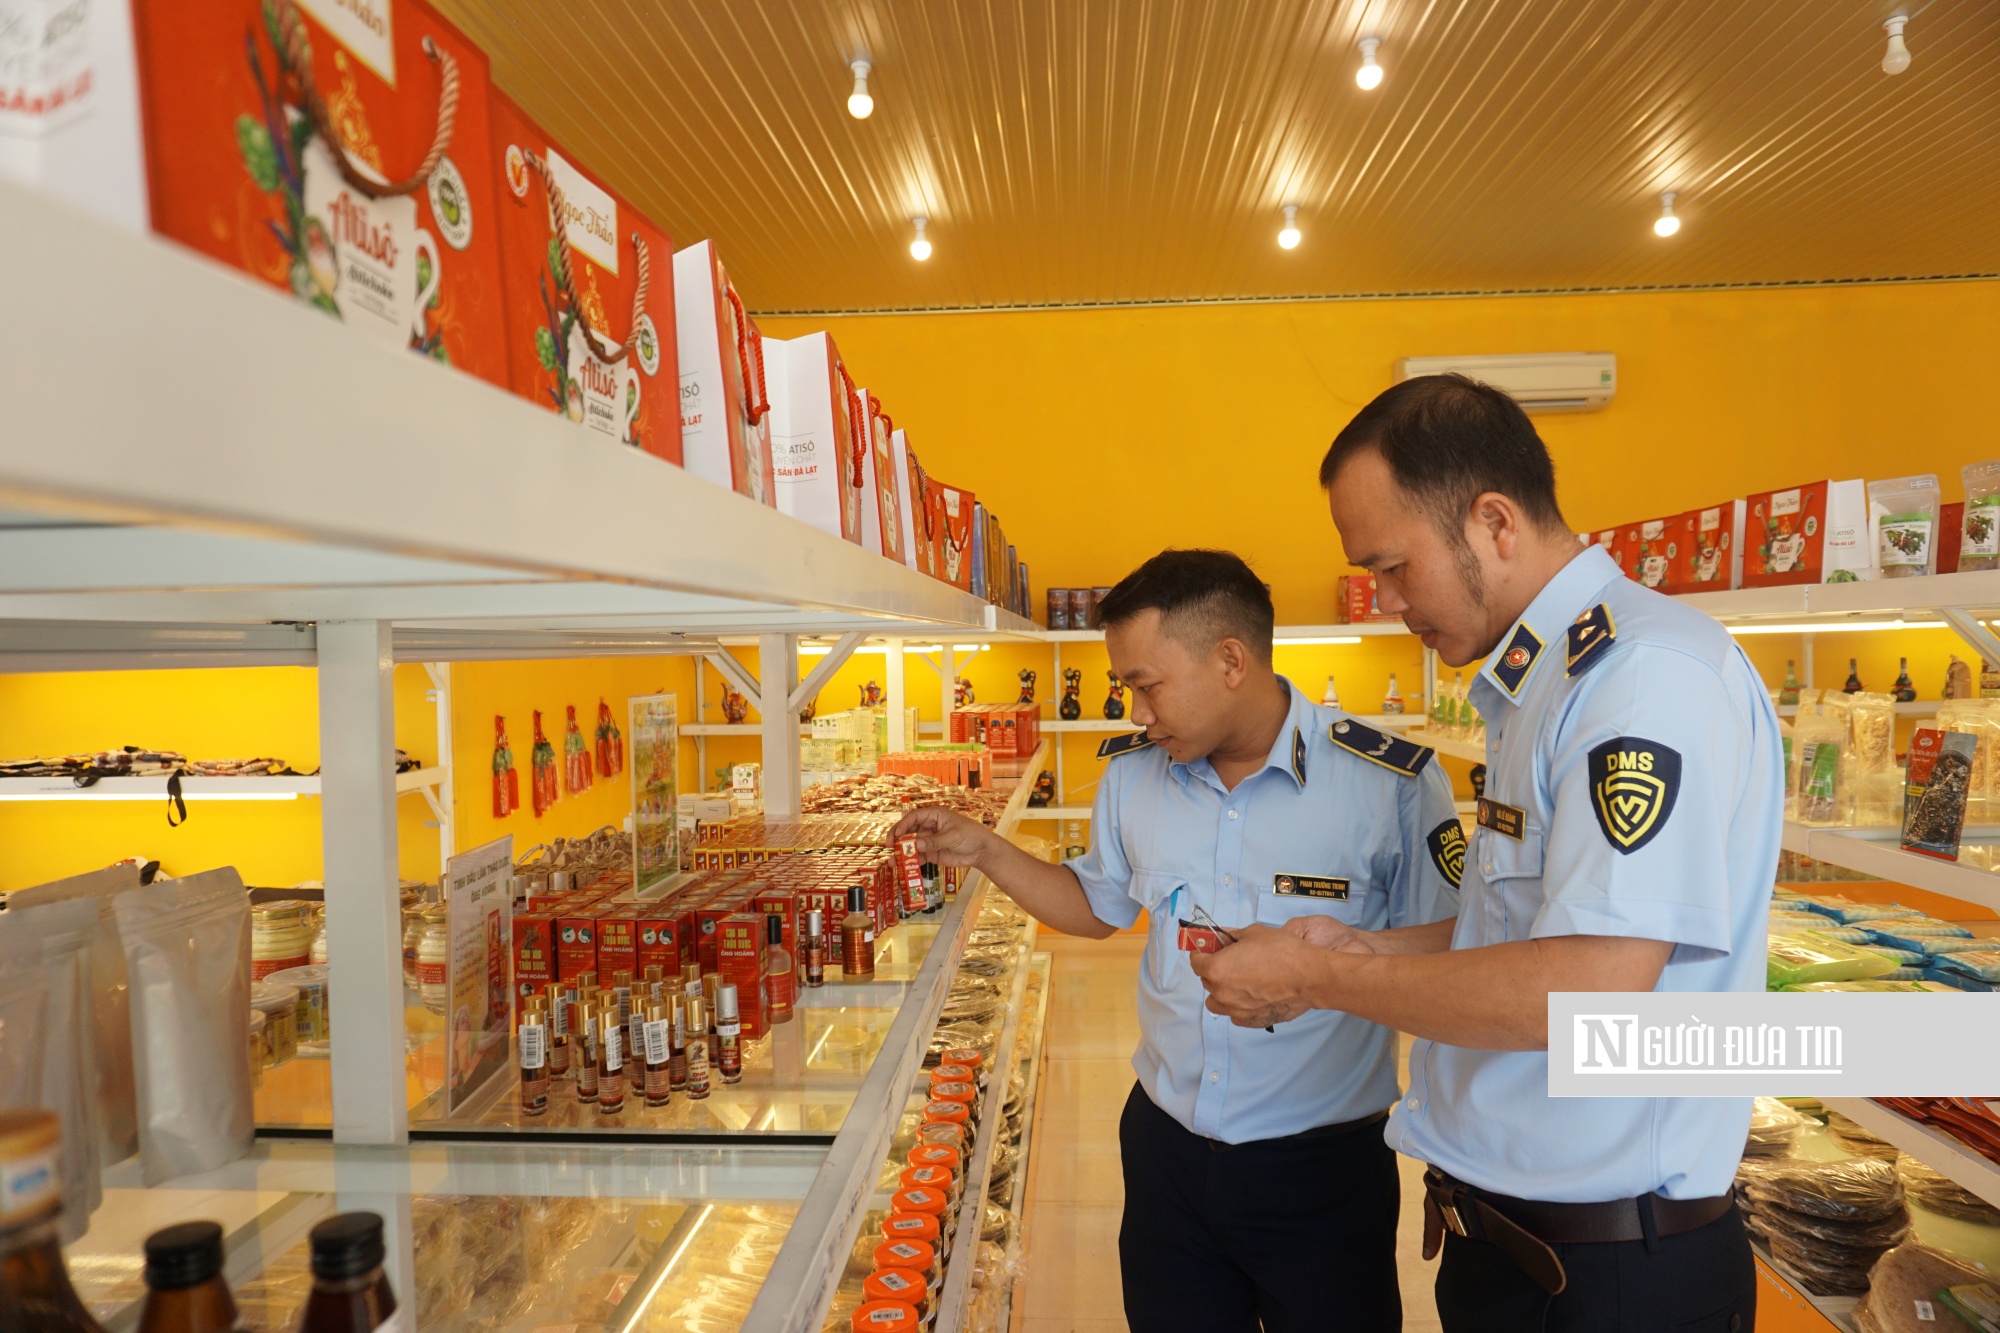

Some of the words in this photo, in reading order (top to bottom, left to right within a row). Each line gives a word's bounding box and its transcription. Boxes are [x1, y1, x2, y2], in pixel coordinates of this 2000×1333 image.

[327, 190, 399, 269] Atisô
[579, 355, 619, 400] Atisô
[688, 413, 702, 428] LẠT
[789, 440, 815, 454] ATISÔ
[777, 466, 793, 476] SẢN
[805, 465, 818, 476] LẠT
[1607, 751, 1655, 773] DMS
[1440, 825, 1460, 846] DMS
[614, 945, 634, 953] HOÀNG
[734, 949, 755, 957] HOÀNG
